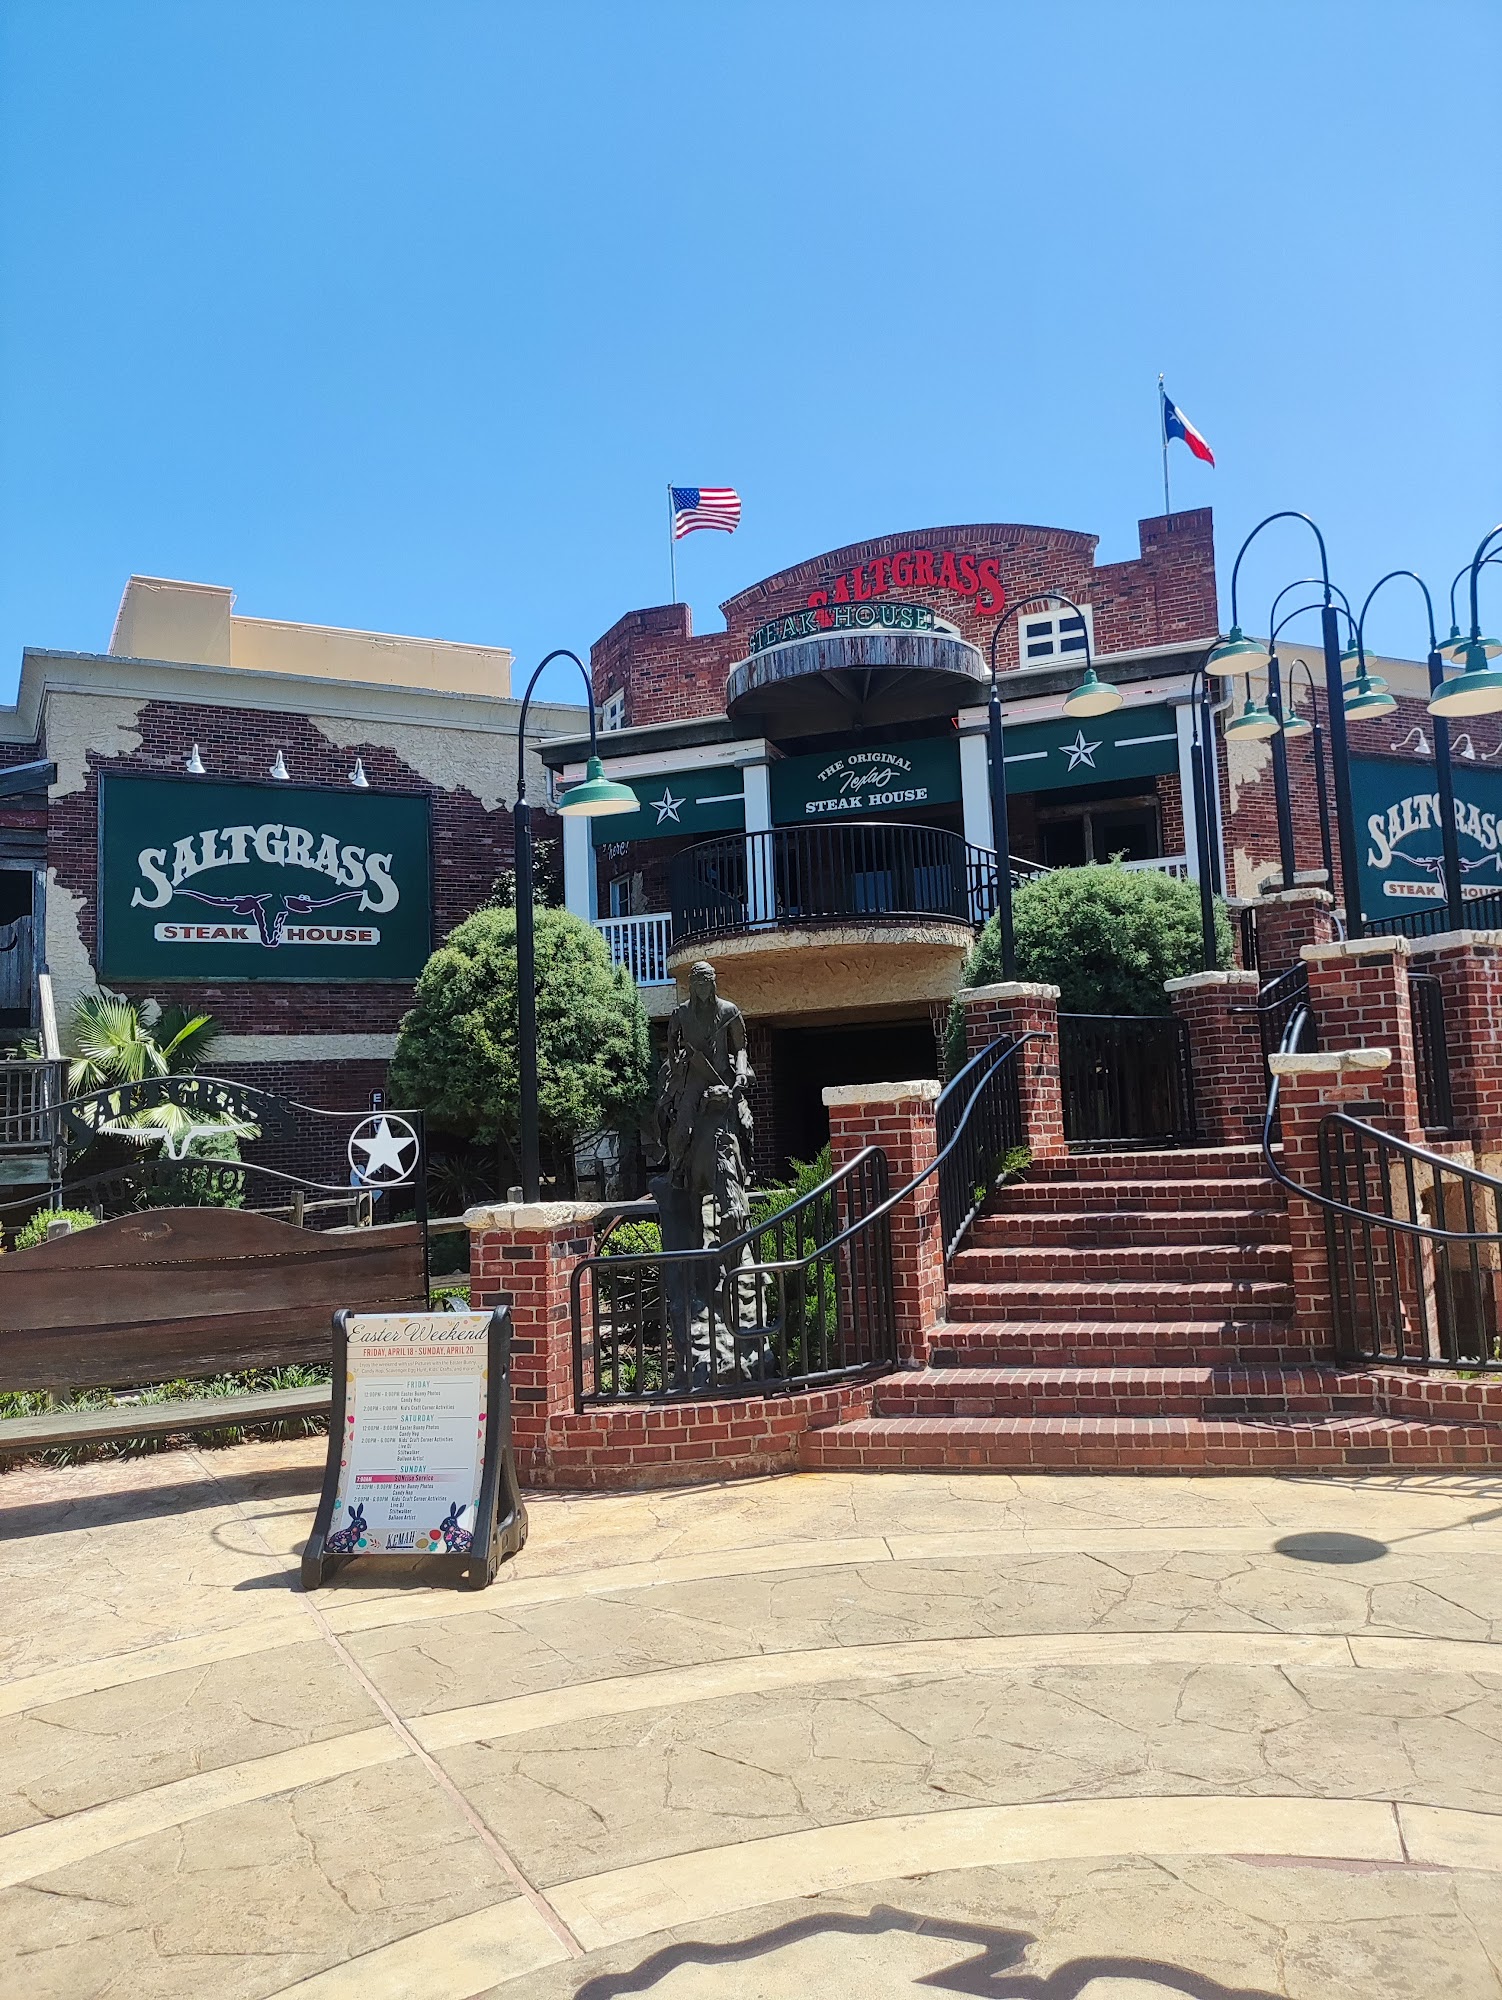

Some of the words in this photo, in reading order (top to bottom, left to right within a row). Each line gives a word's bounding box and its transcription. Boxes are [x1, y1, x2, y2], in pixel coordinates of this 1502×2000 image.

[808, 550, 1005, 628] SALTGRASS
[750, 609, 818, 654] STEAK
[833, 606, 931, 630] HOUSE
[817, 760, 845, 782] THE
[848, 753, 912, 772] ORIGINAL
[839, 766, 900, 794] Texas
[805, 796, 862, 814] STEAK
[868, 787, 928, 806] HOUSE
[1367, 792, 1502, 869] SALTRAS
[130, 824, 400, 913] SALTGRASS
[1388, 883, 1436, 896] STEAK
[163, 926, 249, 940] STEAK
[287, 929, 372, 942] HOUSE
[60, 1076, 297, 1153] SALTGRASS
[347, 1324, 402, 1344] Easter
[403, 1321, 490, 1342] Weekend
[363, 1348, 387, 1357] FRIDAY,
[388, 1348, 406, 1356] APRIL
[407, 1347, 414, 1356] 18
[418, 1347, 446, 1356] SUNDAY,
[446, 1346, 465, 1355] APRIL
[466, 1345, 474, 1354] 20
[400, 1414, 435, 1422] SATURDAY
[399, 1465, 427, 1473] SUNDAY
[386, 1530, 417, 1548] KEMAH
